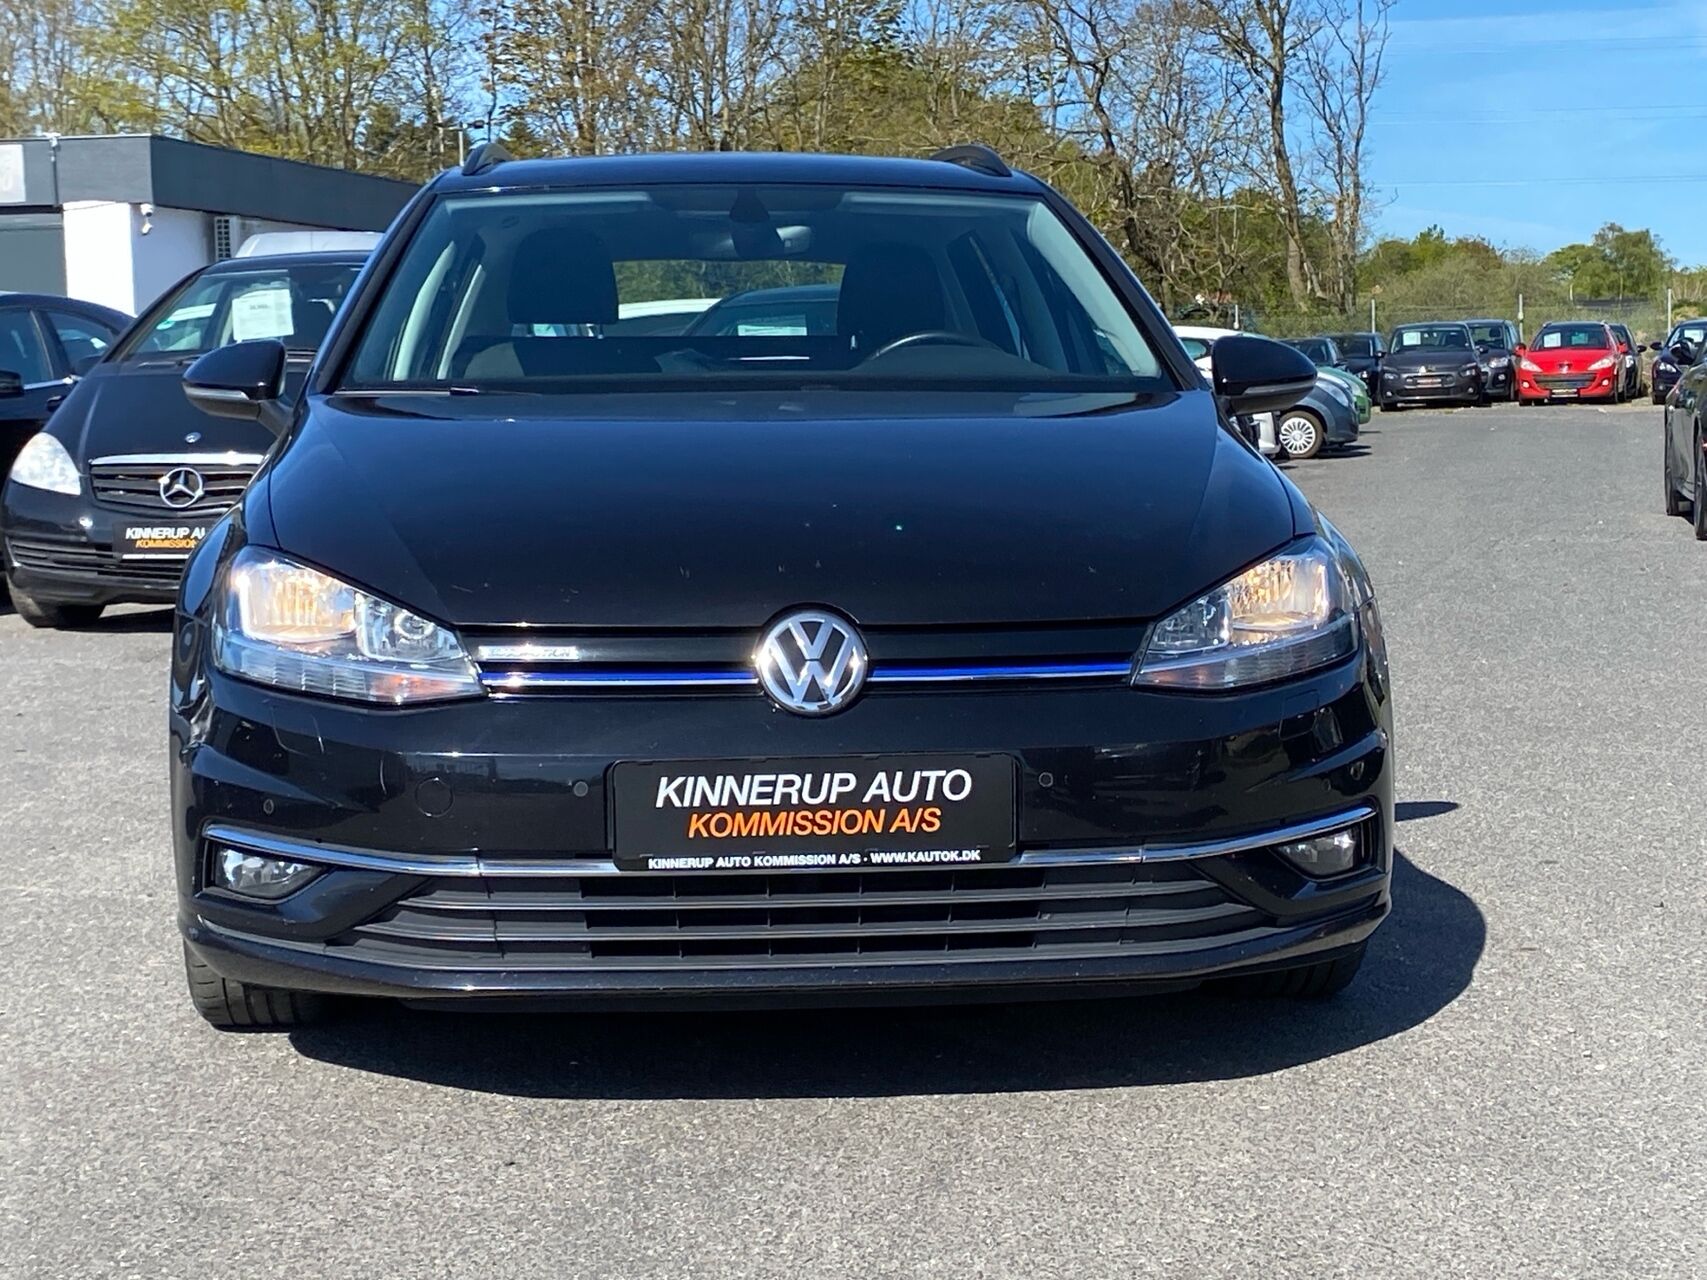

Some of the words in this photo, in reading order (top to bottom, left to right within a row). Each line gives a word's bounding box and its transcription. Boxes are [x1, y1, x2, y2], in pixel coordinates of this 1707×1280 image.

[125, 527, 189, 539] KINNERUP
[655, 773, 857, 808] KINNERUP
[861, 769, 973, 803] AUTO
[688, 808, 886, 838] KOMMISSION
[889, 807, 942, 833] A/S
[648, 856, 714, 869] KINNERUP
[715, 855, 752, 868] AUTO
[753, 853, 836, 867] KOMMISSION
[838, 852, 862, 865] A/S
[870, 850, 982, 864] WWW.KAUTOK.DK
